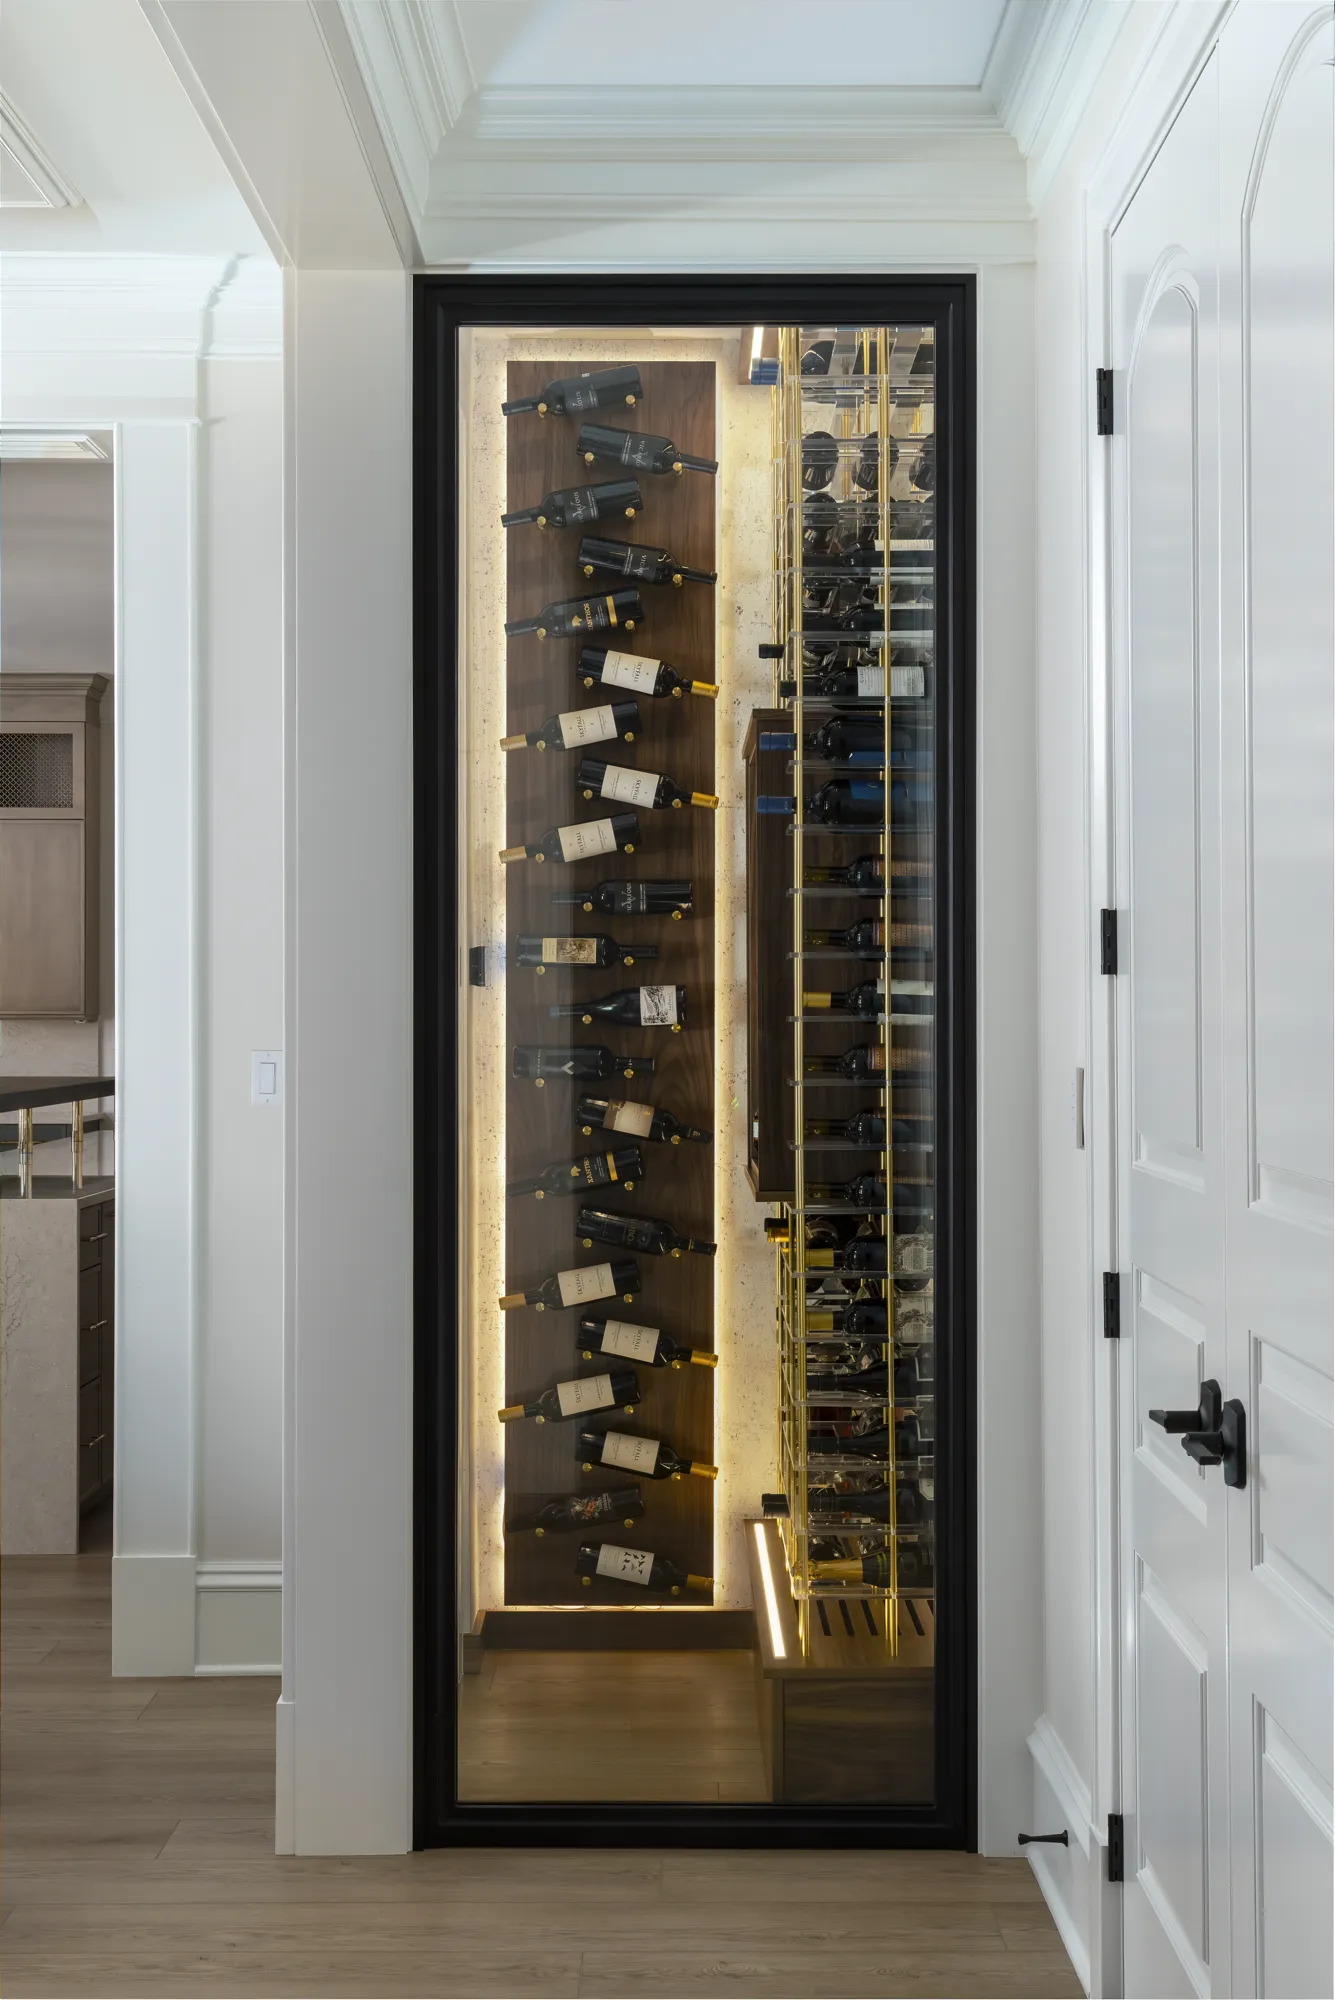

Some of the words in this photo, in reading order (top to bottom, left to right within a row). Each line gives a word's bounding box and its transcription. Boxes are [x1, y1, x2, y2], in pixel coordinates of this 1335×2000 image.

[632, 440, 648, 467] VICARIO
[633, 661, 644, 683] SKYFALL
[575, 716, 585, 738] SKYFALL
[632, 779, 642, 801] SKYFALL
[575, 831, 585, 854] SKYFALL
[583, 1157, 594, 1184] XANTHO
[574, 1273, 584, 1295] SKYFALL
[633, 1329, 644, 1351] SKYFALL
[634, 1440, 644, 1462] SKYFALL
